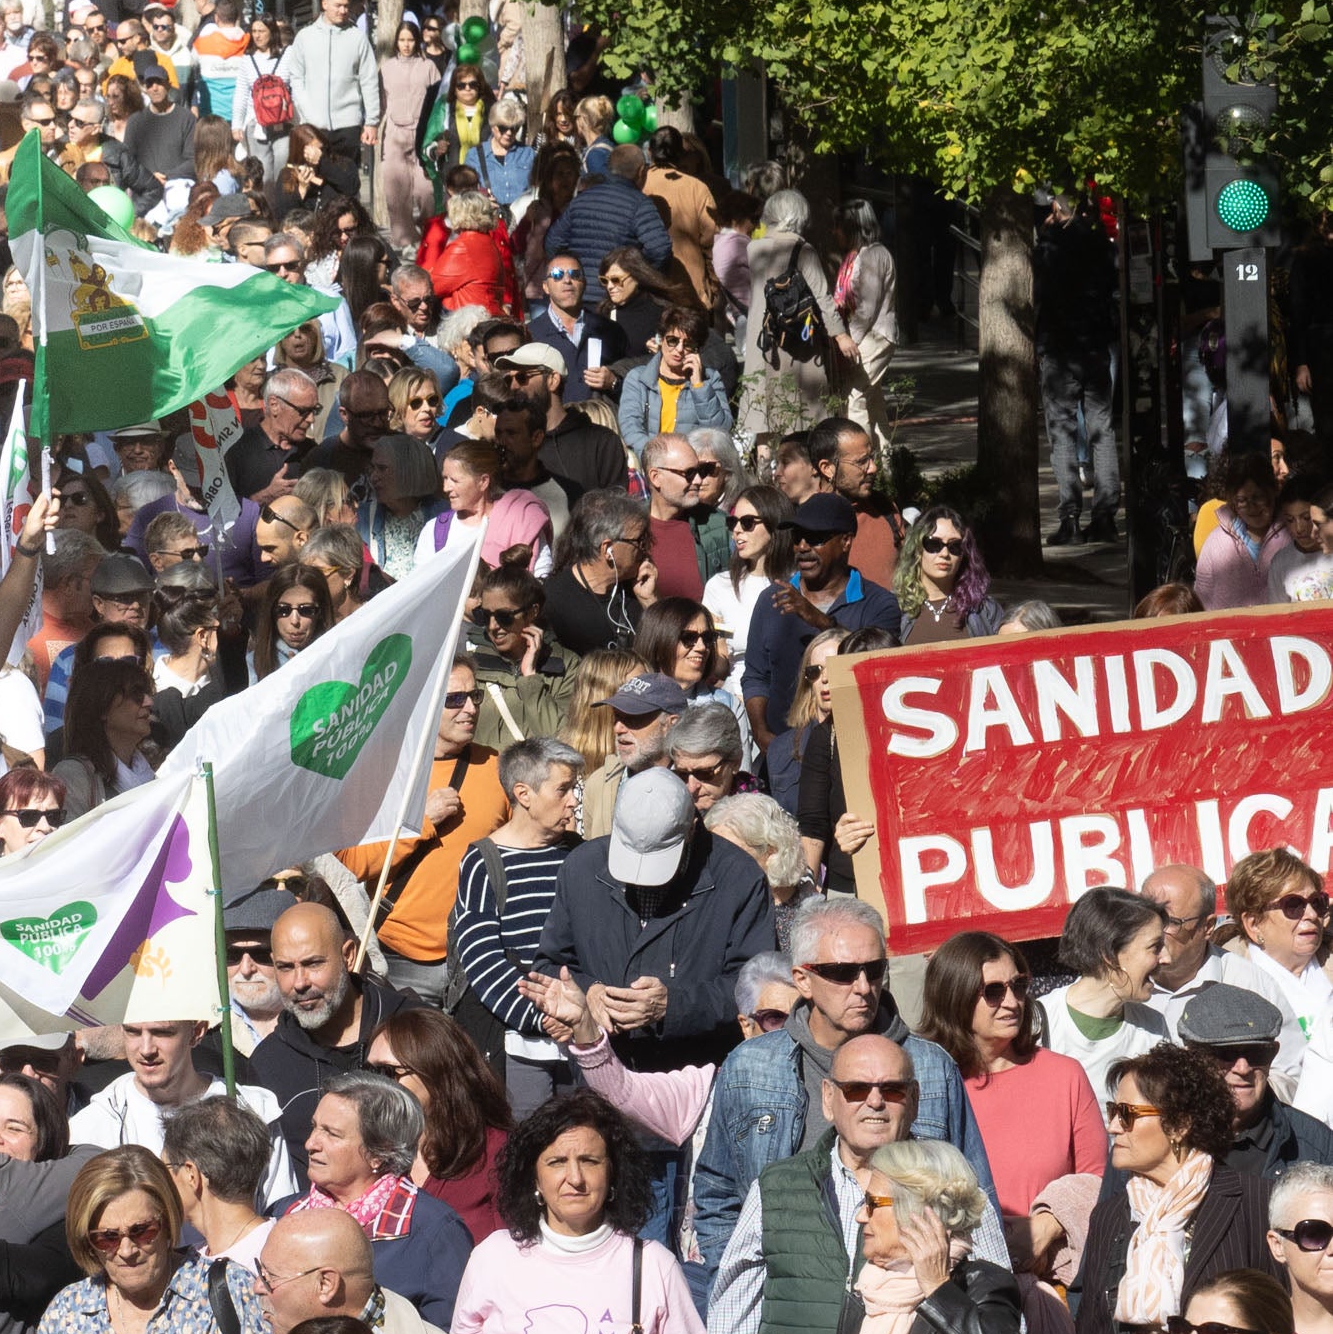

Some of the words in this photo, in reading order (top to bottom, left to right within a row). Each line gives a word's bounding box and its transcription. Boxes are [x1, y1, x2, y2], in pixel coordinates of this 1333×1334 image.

[1236, 264, 1258, 281] 12
[90, 324, 107, 332] POR
[313, 661, 397, 740] SANIDAD
[882, 635, 1333, 758] SANIDAD
[326, 718, 373, 767] 100%
[15, 913, 83, 933] SANIDAD
